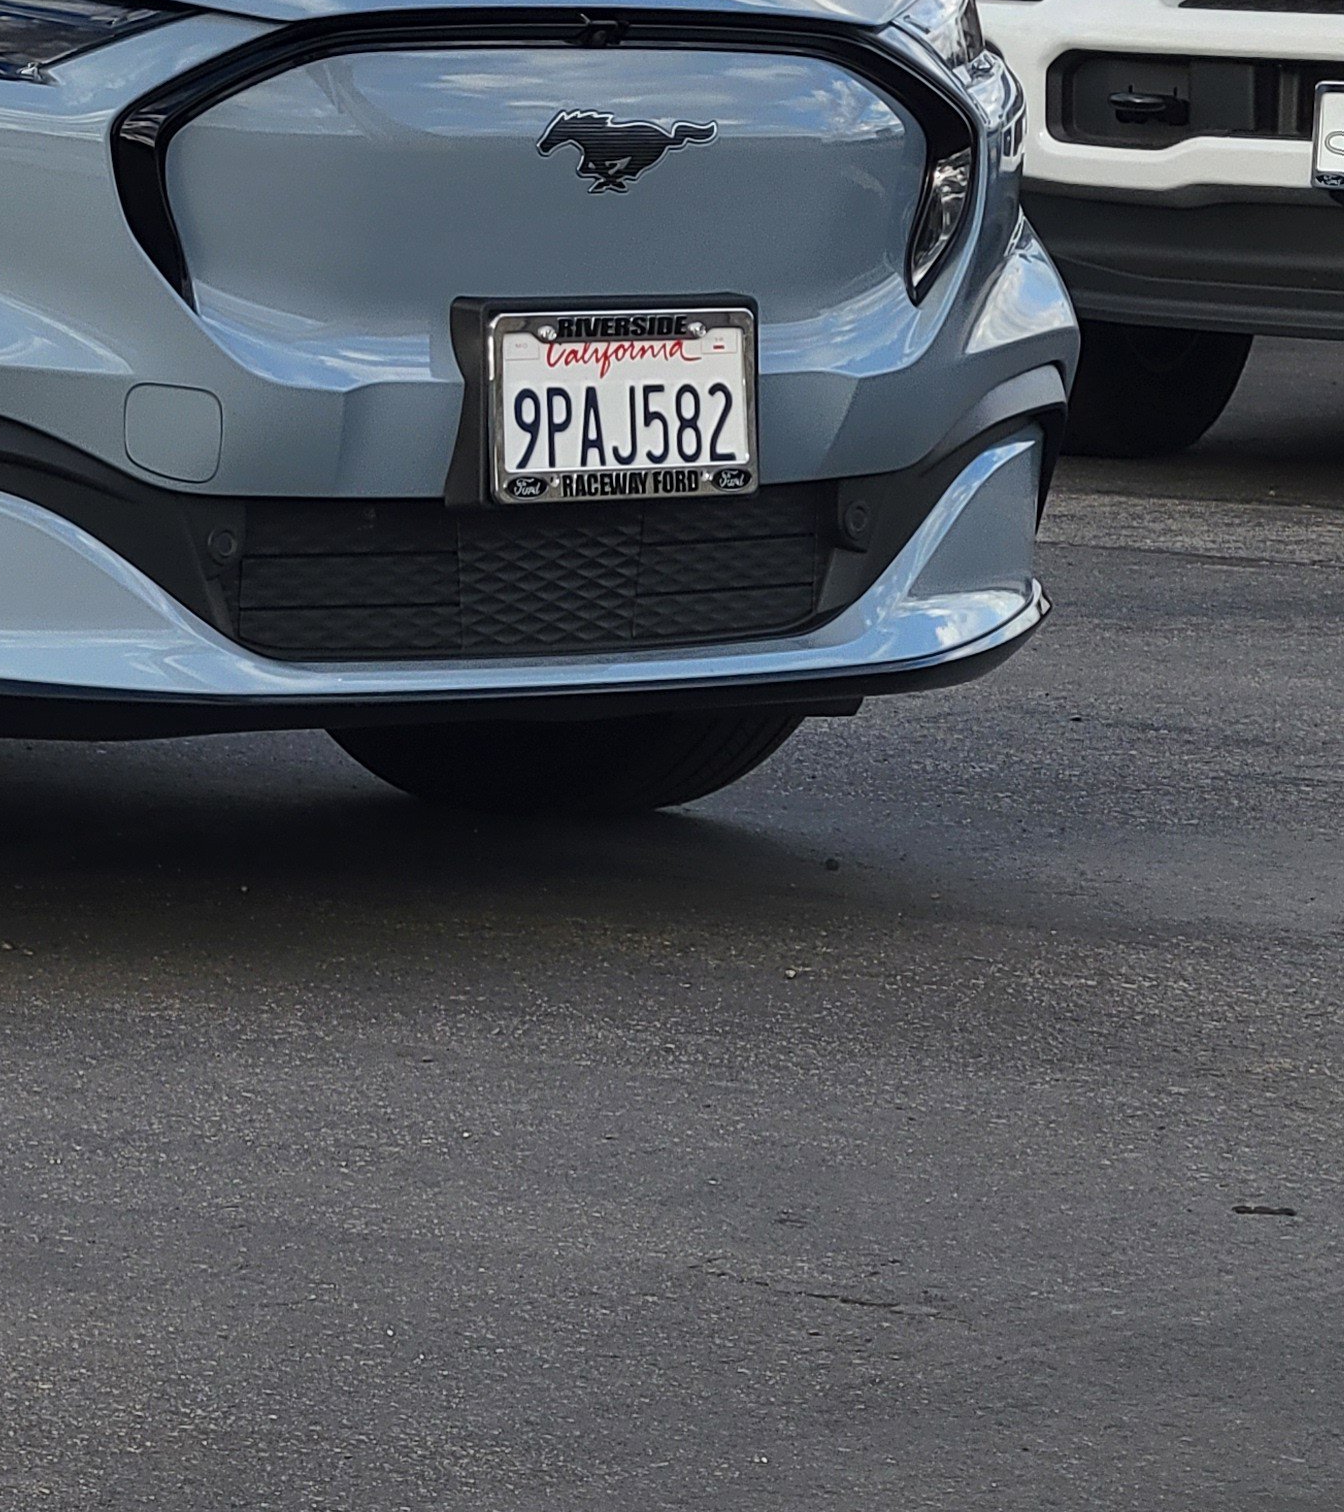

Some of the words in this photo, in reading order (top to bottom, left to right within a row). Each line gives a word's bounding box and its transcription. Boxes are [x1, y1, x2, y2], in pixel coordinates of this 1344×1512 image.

[557, 315, 688, 339] RIVERSIDE
[546, 339, 702, 379] California
[514, 381, 737, 470] 9PAJ582
[512, 477, 543, 497] Ford
[562, 472, 650, 498] RACEWAY
[652, 469, 699, 494] FORD
[718, 469, 745, 488] Ford
